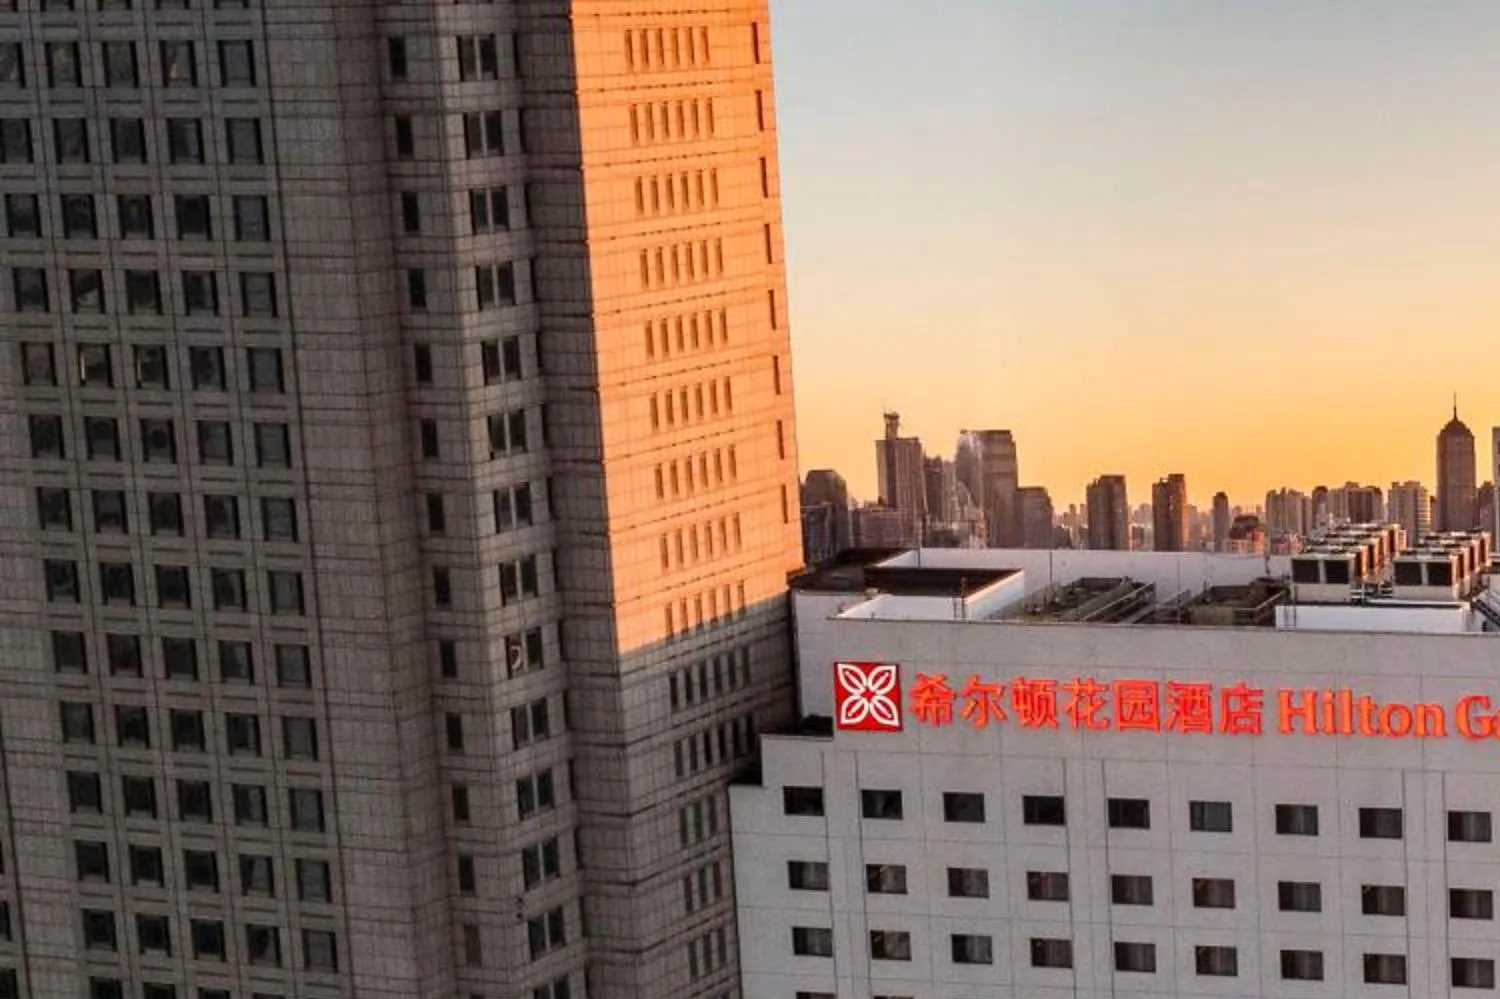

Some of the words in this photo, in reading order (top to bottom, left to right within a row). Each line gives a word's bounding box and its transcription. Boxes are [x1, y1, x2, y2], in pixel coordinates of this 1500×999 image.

[907, 672, 1264, 736] 希尔顿花园酒店
[1276, 687, 1448, 739] Hilton
